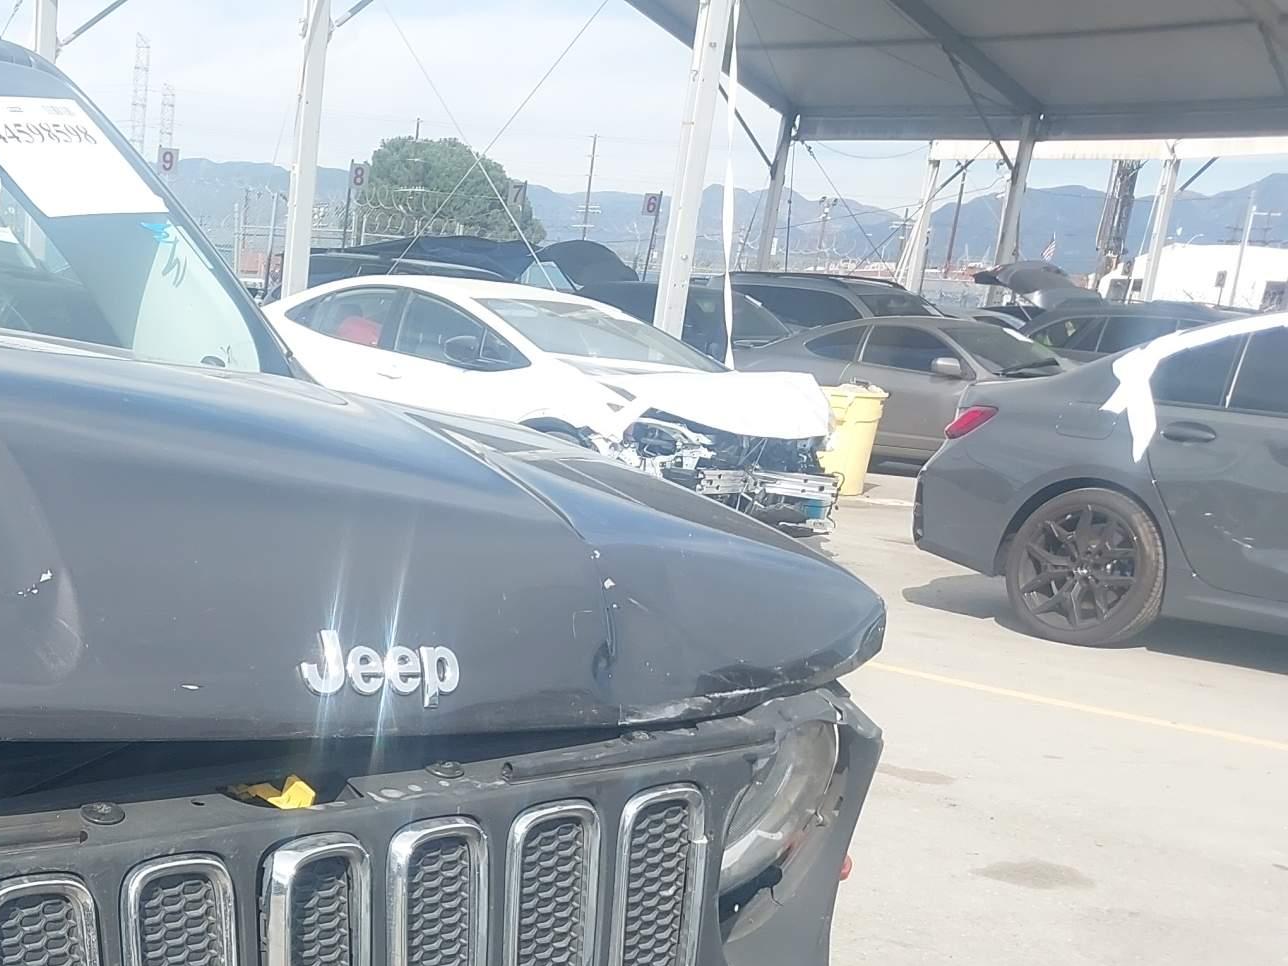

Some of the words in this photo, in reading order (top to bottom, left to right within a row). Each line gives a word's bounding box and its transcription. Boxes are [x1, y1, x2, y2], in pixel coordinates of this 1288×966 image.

[162, 151, 174, 171] 9
[353, 166, 364, 185] 8
[512, 184, 523, 203] 7
[647, 195, 657, 213] 6
[297, 629, 460, 709] Jeep
